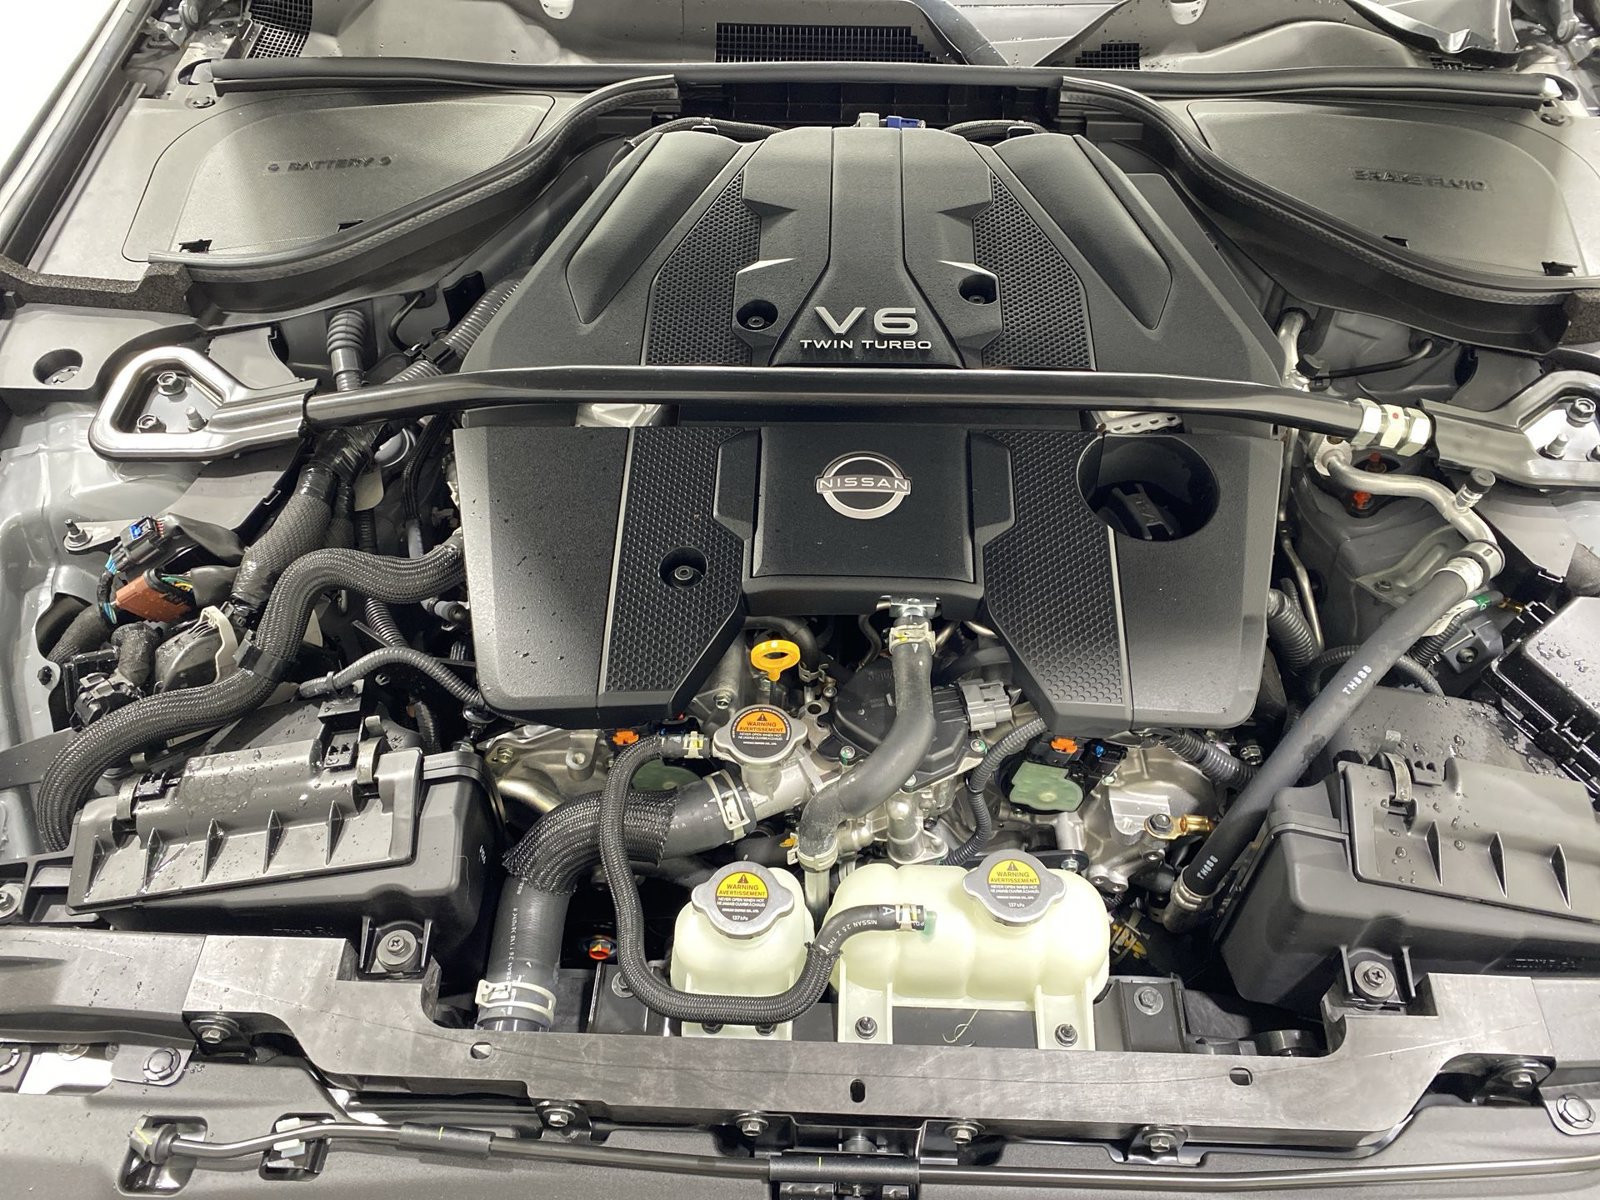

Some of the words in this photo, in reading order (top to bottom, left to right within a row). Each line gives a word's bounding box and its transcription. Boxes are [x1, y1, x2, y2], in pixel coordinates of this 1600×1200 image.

[287, 158, 374, 172] BATTERY
[814, 306, 918, 336] V6
[799, 339, 854, 349] TWIN
[861, 340, 932, 351] TURBO
[819, 477, 908, 491] NISSAN
[852, 919, 878, 928] NISSAN
